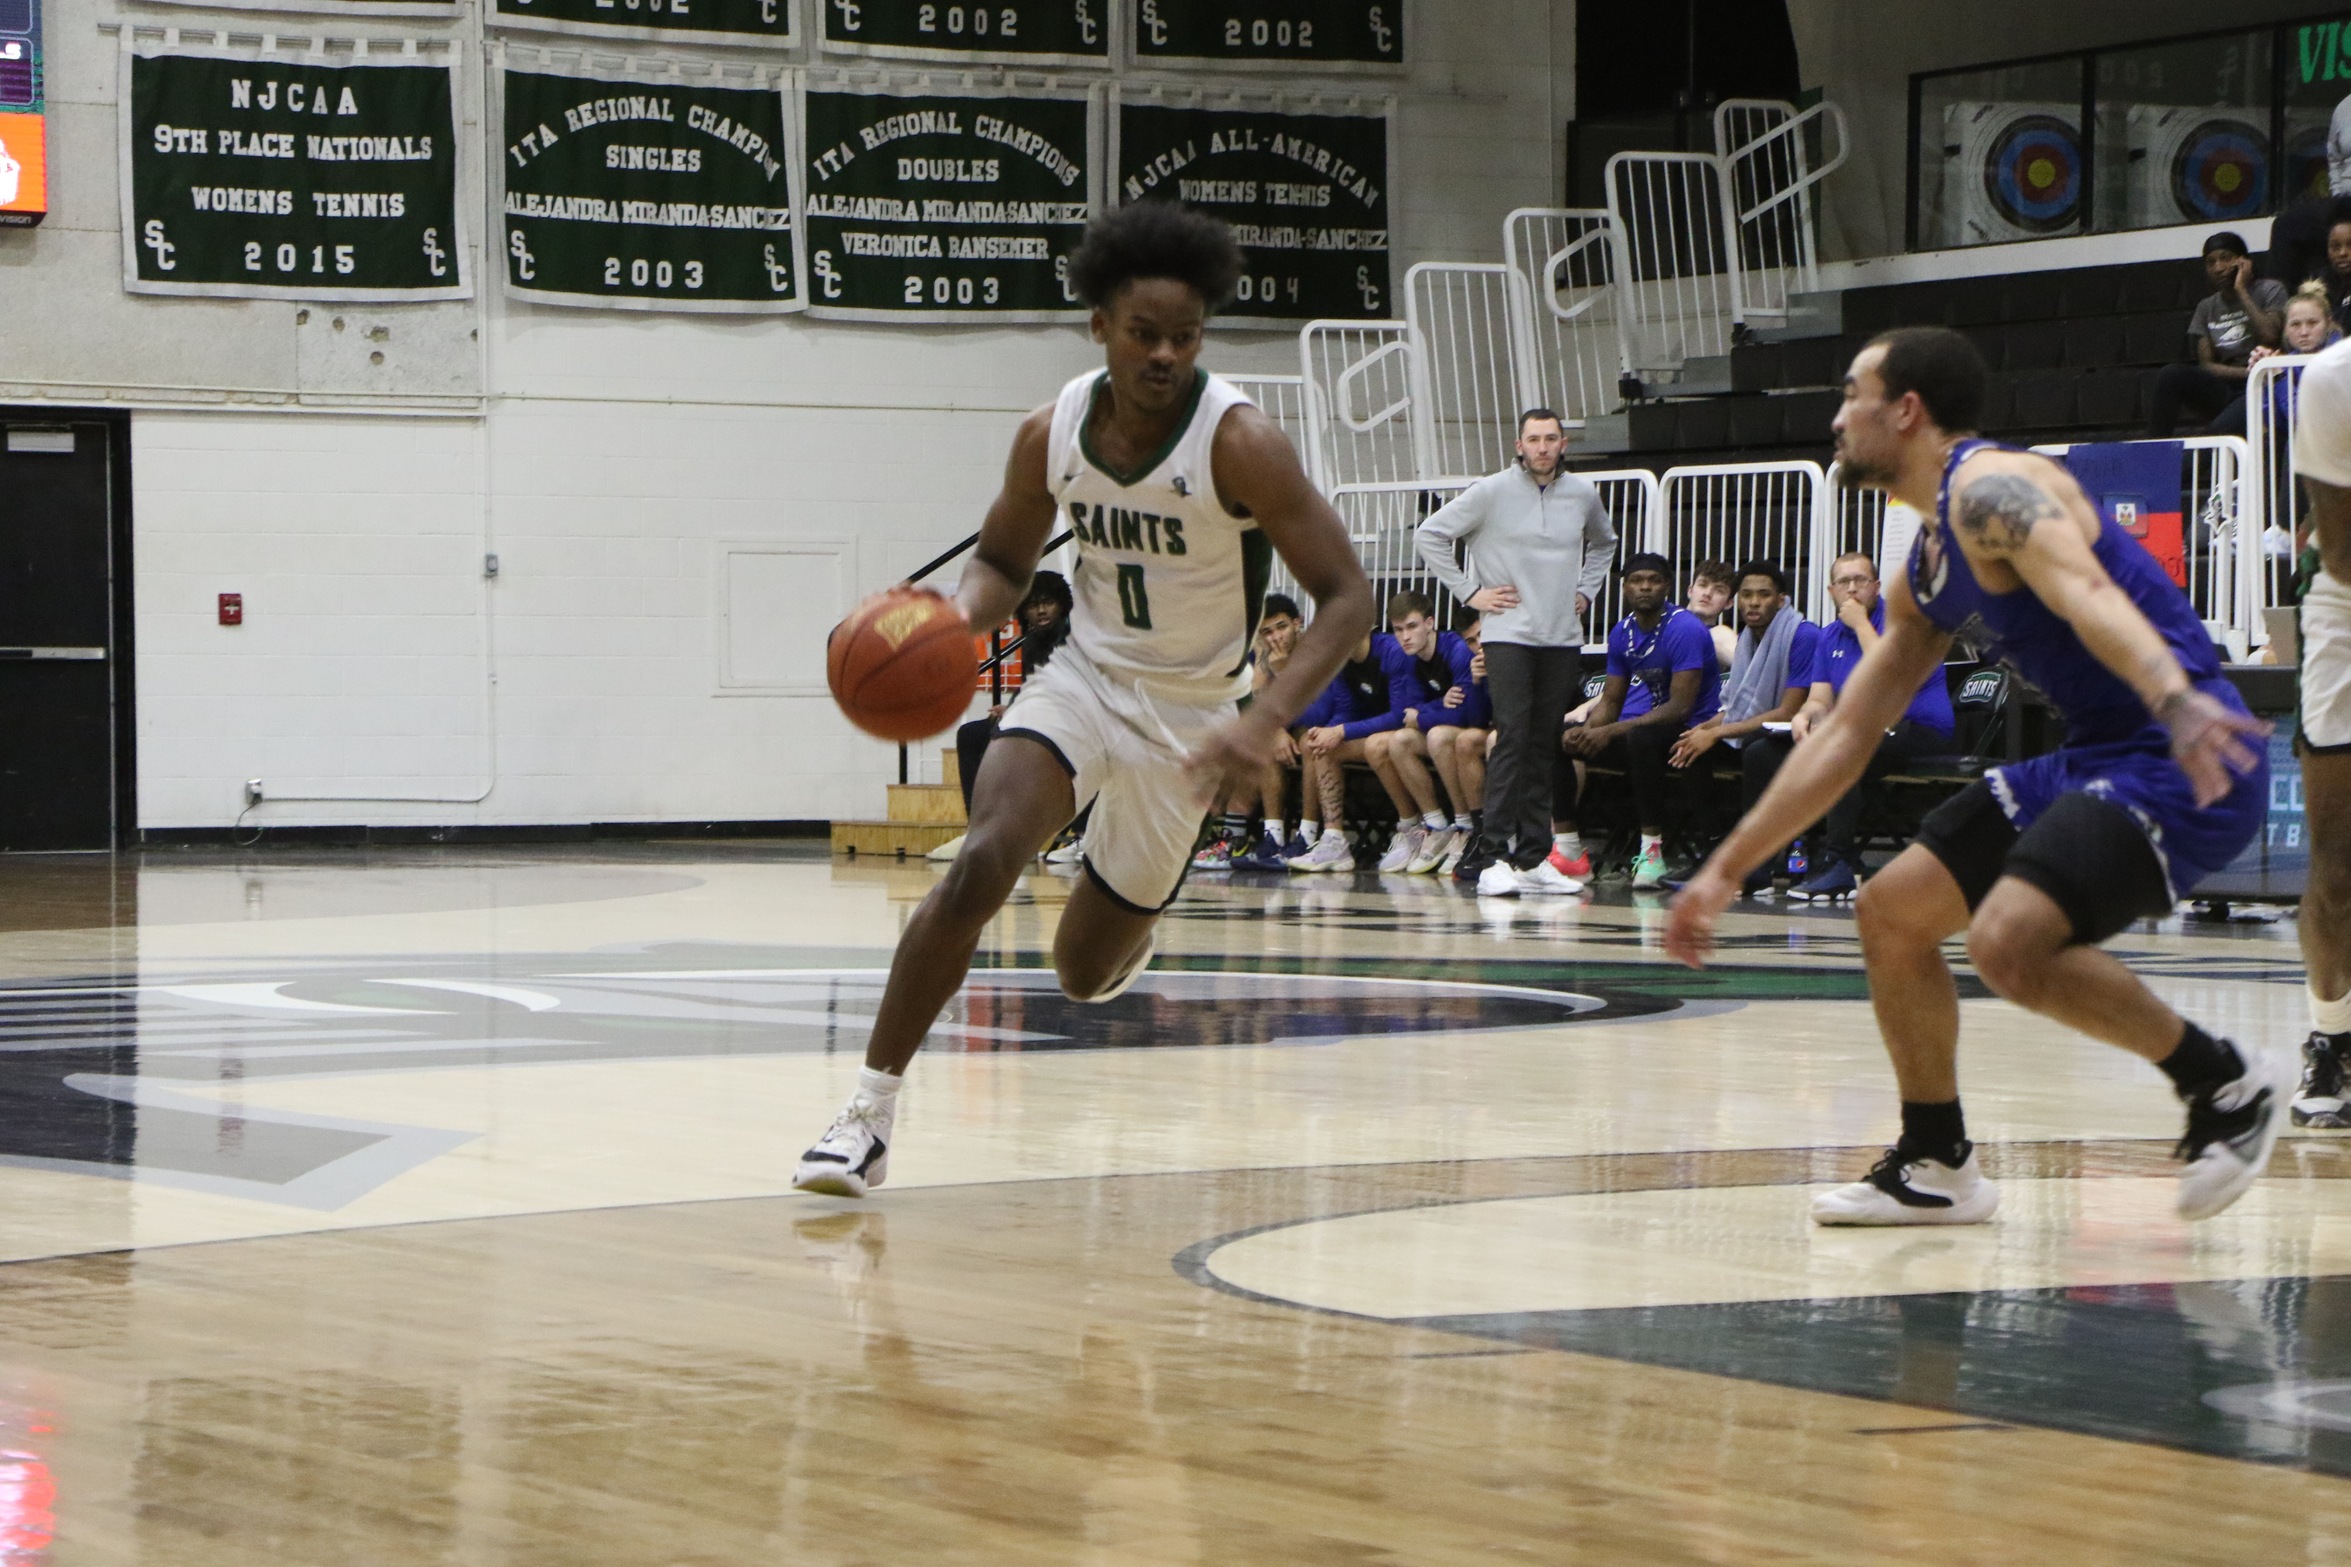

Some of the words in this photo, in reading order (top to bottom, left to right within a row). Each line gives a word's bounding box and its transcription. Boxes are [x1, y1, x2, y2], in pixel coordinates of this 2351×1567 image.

[919, 5, 1017, 36] 2002
[1225, 19, 1313, 47] 2002
[231, 79, 358, 115] NJCAA
[154, 124, 208, 153] 9TH
[219, 130, 295, 158] PLACE
[307, 135, 432, 161] NATIONALS
[509, 123, 559, 168] ITA
[565, 96, 675, 133] REGIONAL
[687, 104, 781, 182] CHAMPI
[812, 141, 855, 181] ITA
[859, 110, 962, 150] REGIONAL
[974, 115, 1080, 187] CHAMPIONS
[606, 144, 702, 173] SINGLES
[897, 158, 1000, 182] DOUBLES
[1125, 139, 1197, 200] NJCAA
[1210, 129, 1380, 209] ALL-AMERICAN
[191, 186, 293, 215] WOMENS
[312, 192, 405, 217] TENNIS
[505, 191, 620, 223] ALEJANDRA
[806, 194, 919, 222] ALEJANDRA
[1179, 178, 1257, 203] WOMENS
[1264, 182, 1332, 207] TENNIS
[245, 242, 355, 274] 2015
[841, 232, 942, 258] VERONICA
[948, 235, 1050, 260] BANSEMER
[604, 257, 703, 289] 2003
[904, 276, 999, 304] 2003
[1236, 275, 1299, 304] 004
[1069, 502, 1187, 556] SAINTS
[1115, 563, 1153, 630] 0
[1963, 680, 1998, 697] SAINTS
